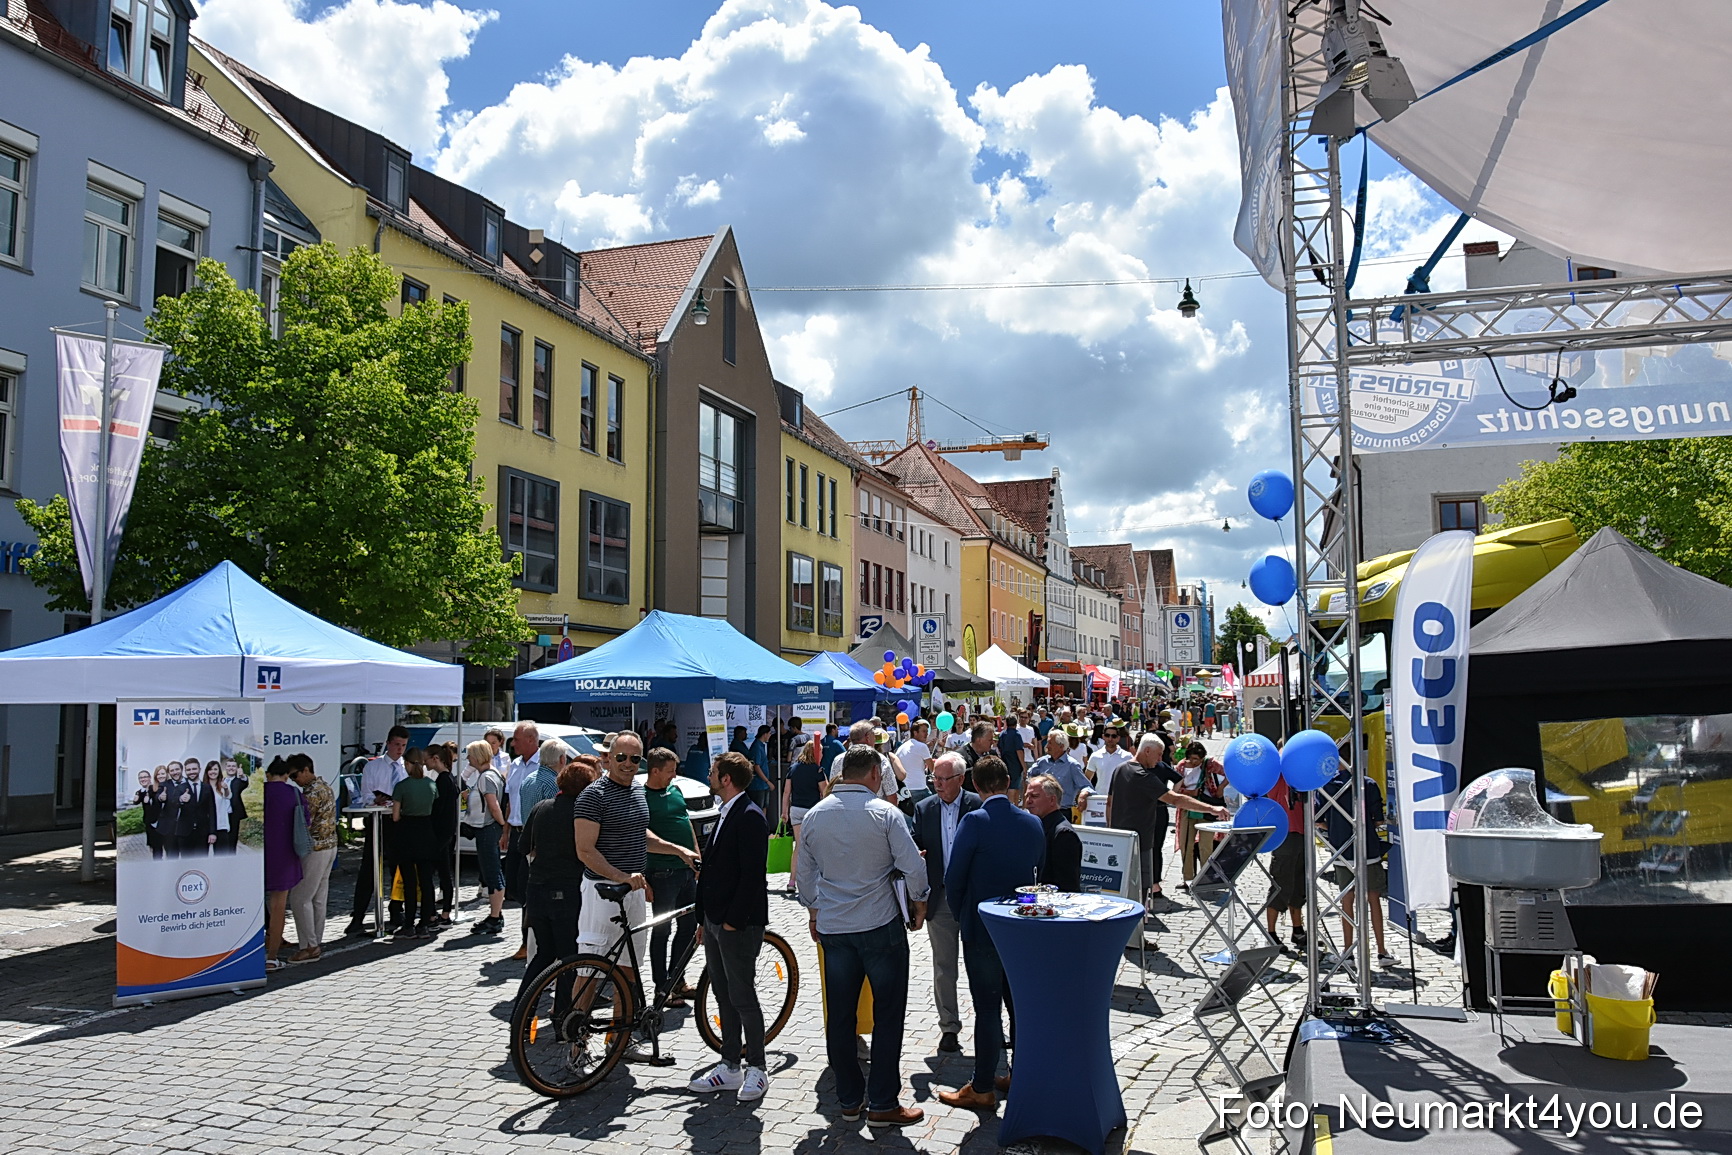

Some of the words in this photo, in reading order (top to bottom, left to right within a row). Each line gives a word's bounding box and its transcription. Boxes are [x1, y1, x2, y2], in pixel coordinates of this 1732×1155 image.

[575, 679, 652, 691] HOLZAMMER
[164, 708, 226, 716] Raiffeisenbank
[1411, 601, 1458, 830] IVECO
[164, 717, 207, 725] Neumarkt
[273, 729, 329, 746] Banker.
[181, 881, 204, 892] next
[138, 913, 170, 923] Werde
[171, 910, 197, 920] mehr
[198, 908, 211, 918] als
[212, 906, 246, 917] Banker.
[160, 922, 187, 933] Bewirb
[188, 921, 205, 930] dich
[205, 919, 226, 930] jetzt!
